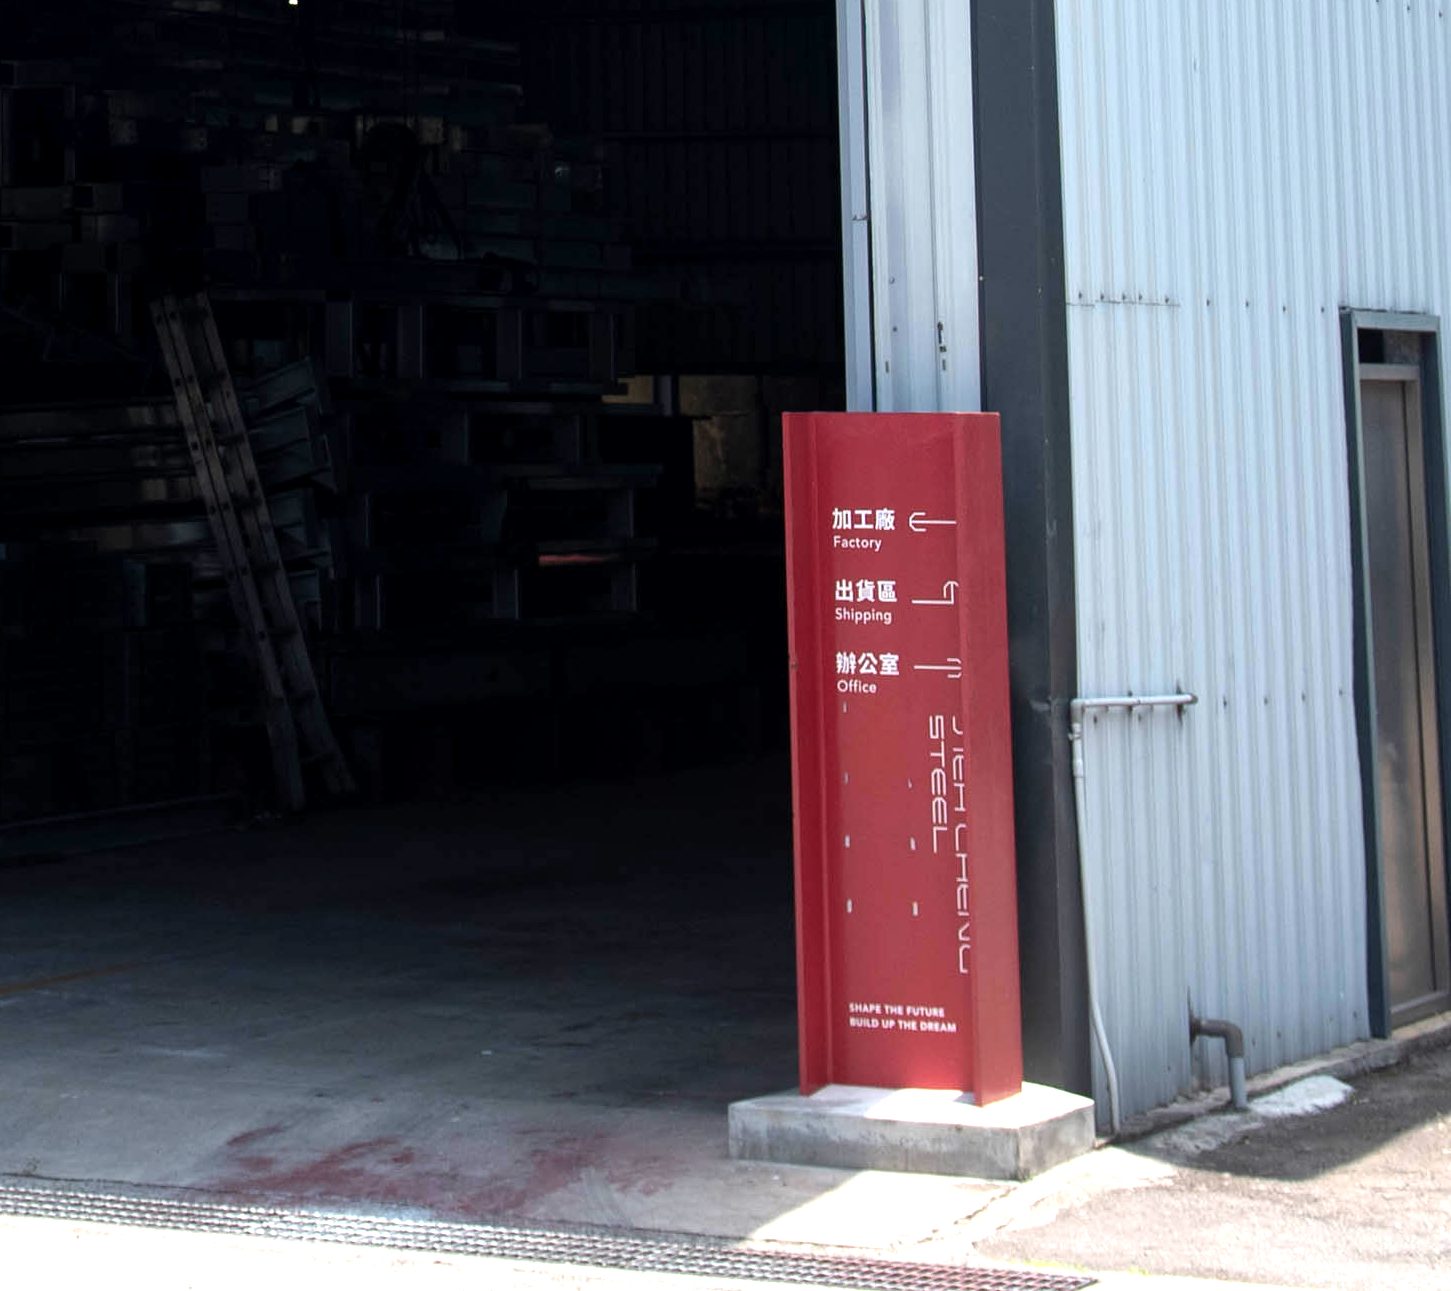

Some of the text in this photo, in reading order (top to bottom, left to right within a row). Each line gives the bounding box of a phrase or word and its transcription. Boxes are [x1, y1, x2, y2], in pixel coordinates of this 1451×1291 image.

[832, 508, 896, 530] 加工廠
[833, 536, 882, 552] Factory
[835, 580, 898, 603] 出貨區
[835, 608, 892, 625] Shipping
[836, 651, 900, 676] 辦公室
[837, 679, 877, 693] Office
[929, 714, 947, 854] STEEL
[849, 1002, 945, 1018] SHAPE THE FUTURE
[849, 1016, 957, 1032] BUILD UP THE DREAM
